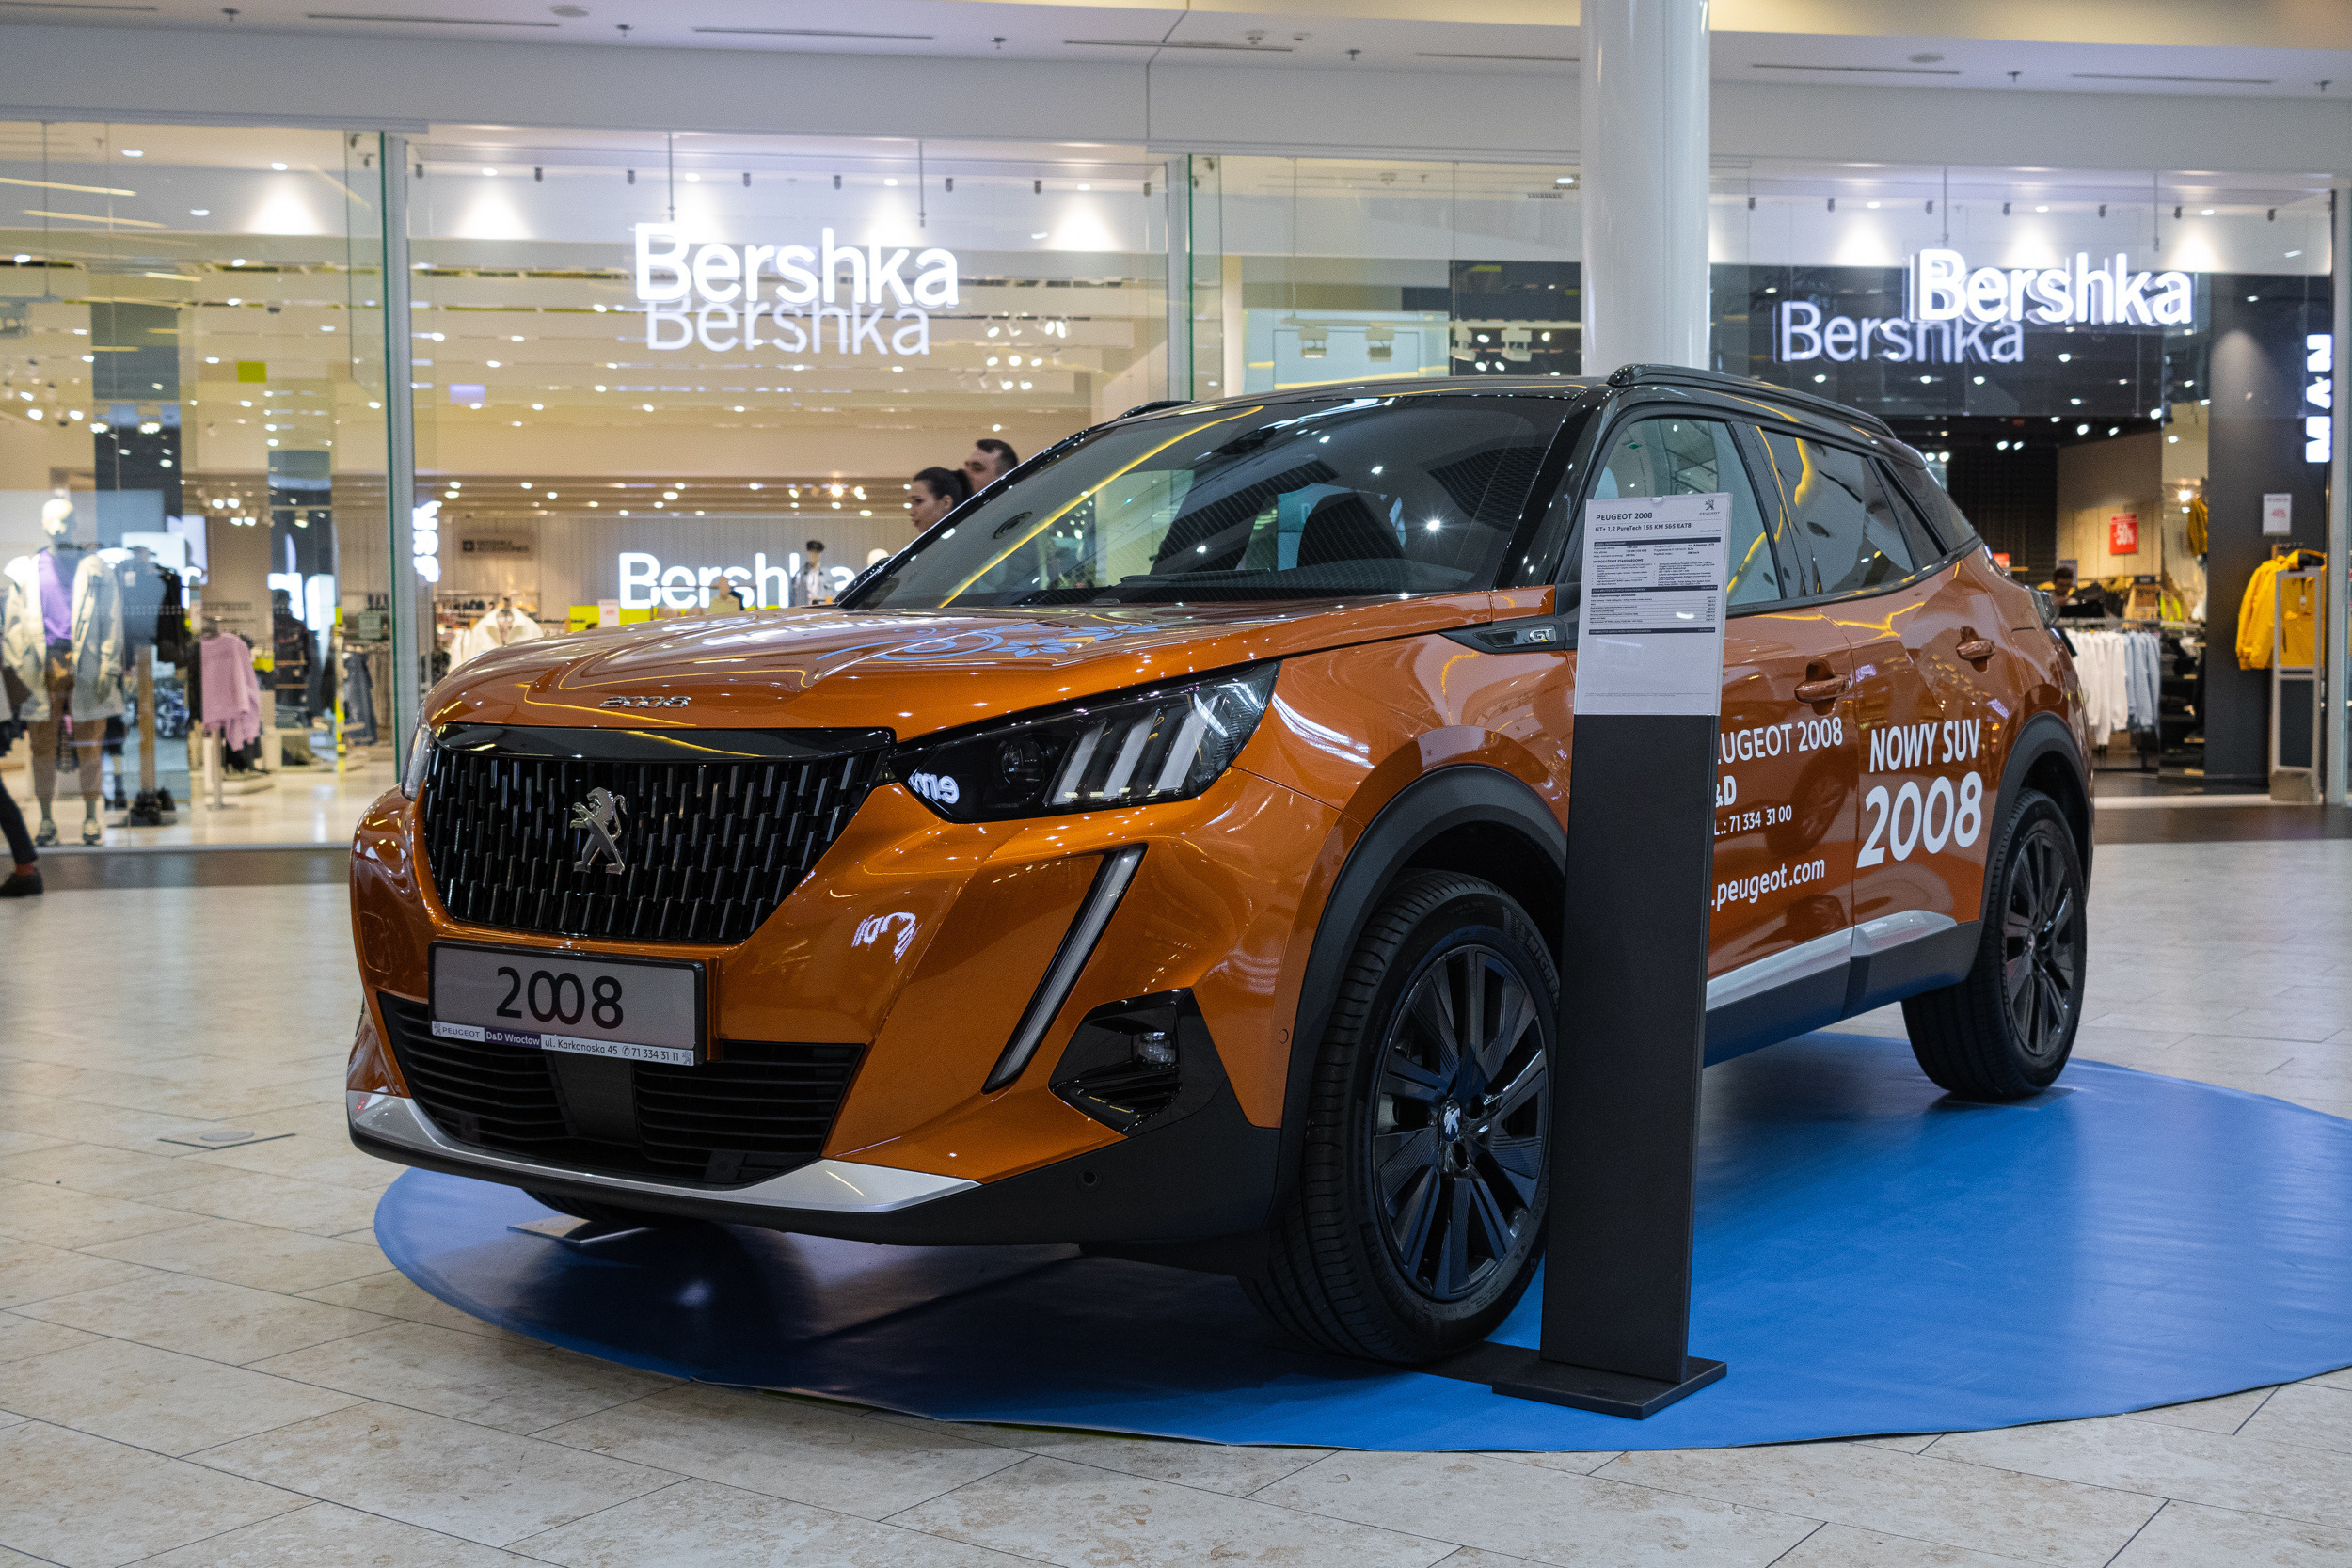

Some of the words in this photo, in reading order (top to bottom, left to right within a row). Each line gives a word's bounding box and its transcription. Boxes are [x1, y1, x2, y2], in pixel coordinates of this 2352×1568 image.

[635, 222, 960, 309] Bershka
[1912, 248, 2193, 325] Bershka
[646, 293, 930, 356] Bershka
[1774, 300, 2025, 364] Bershka
[2305, 333, 2333, 463] MAN
[1596, 513, 1633, 521] PEUGEOT
[1634, 512, 1653, 520] 2008
[1717, 723, 1793, 765] UGEOT
[1797, 716, 1843, 752] 2008
[1869, 722, 1938, 773] NOWY
[1942, 718, 1981, 764] SUV
[1729, 815, 1740, 832] 71
[1742, 811, 1762, 831] 334
[1766, 807, 1776, 826] 31
[1778, 804, 1793, 823] 00
[1856, 770, 1983, 869] 2008
[496, 966, 624, 1030] 2008
[442, 1026, 481, 1037] PEUGEOT
[485, 1031, 503, 1041] D&D
[545, 1037, 556, 1048] ul.
[557, 1039, 606, 1053] Karkonoska
[607, 1045, 618, 1055] 45
[631, 1048, 641, 1057] 71
[643, 1049, 659, 1060] 334
[660, 1051, 670, 1061] 31
[671, 1052, 679, 1062] 11
